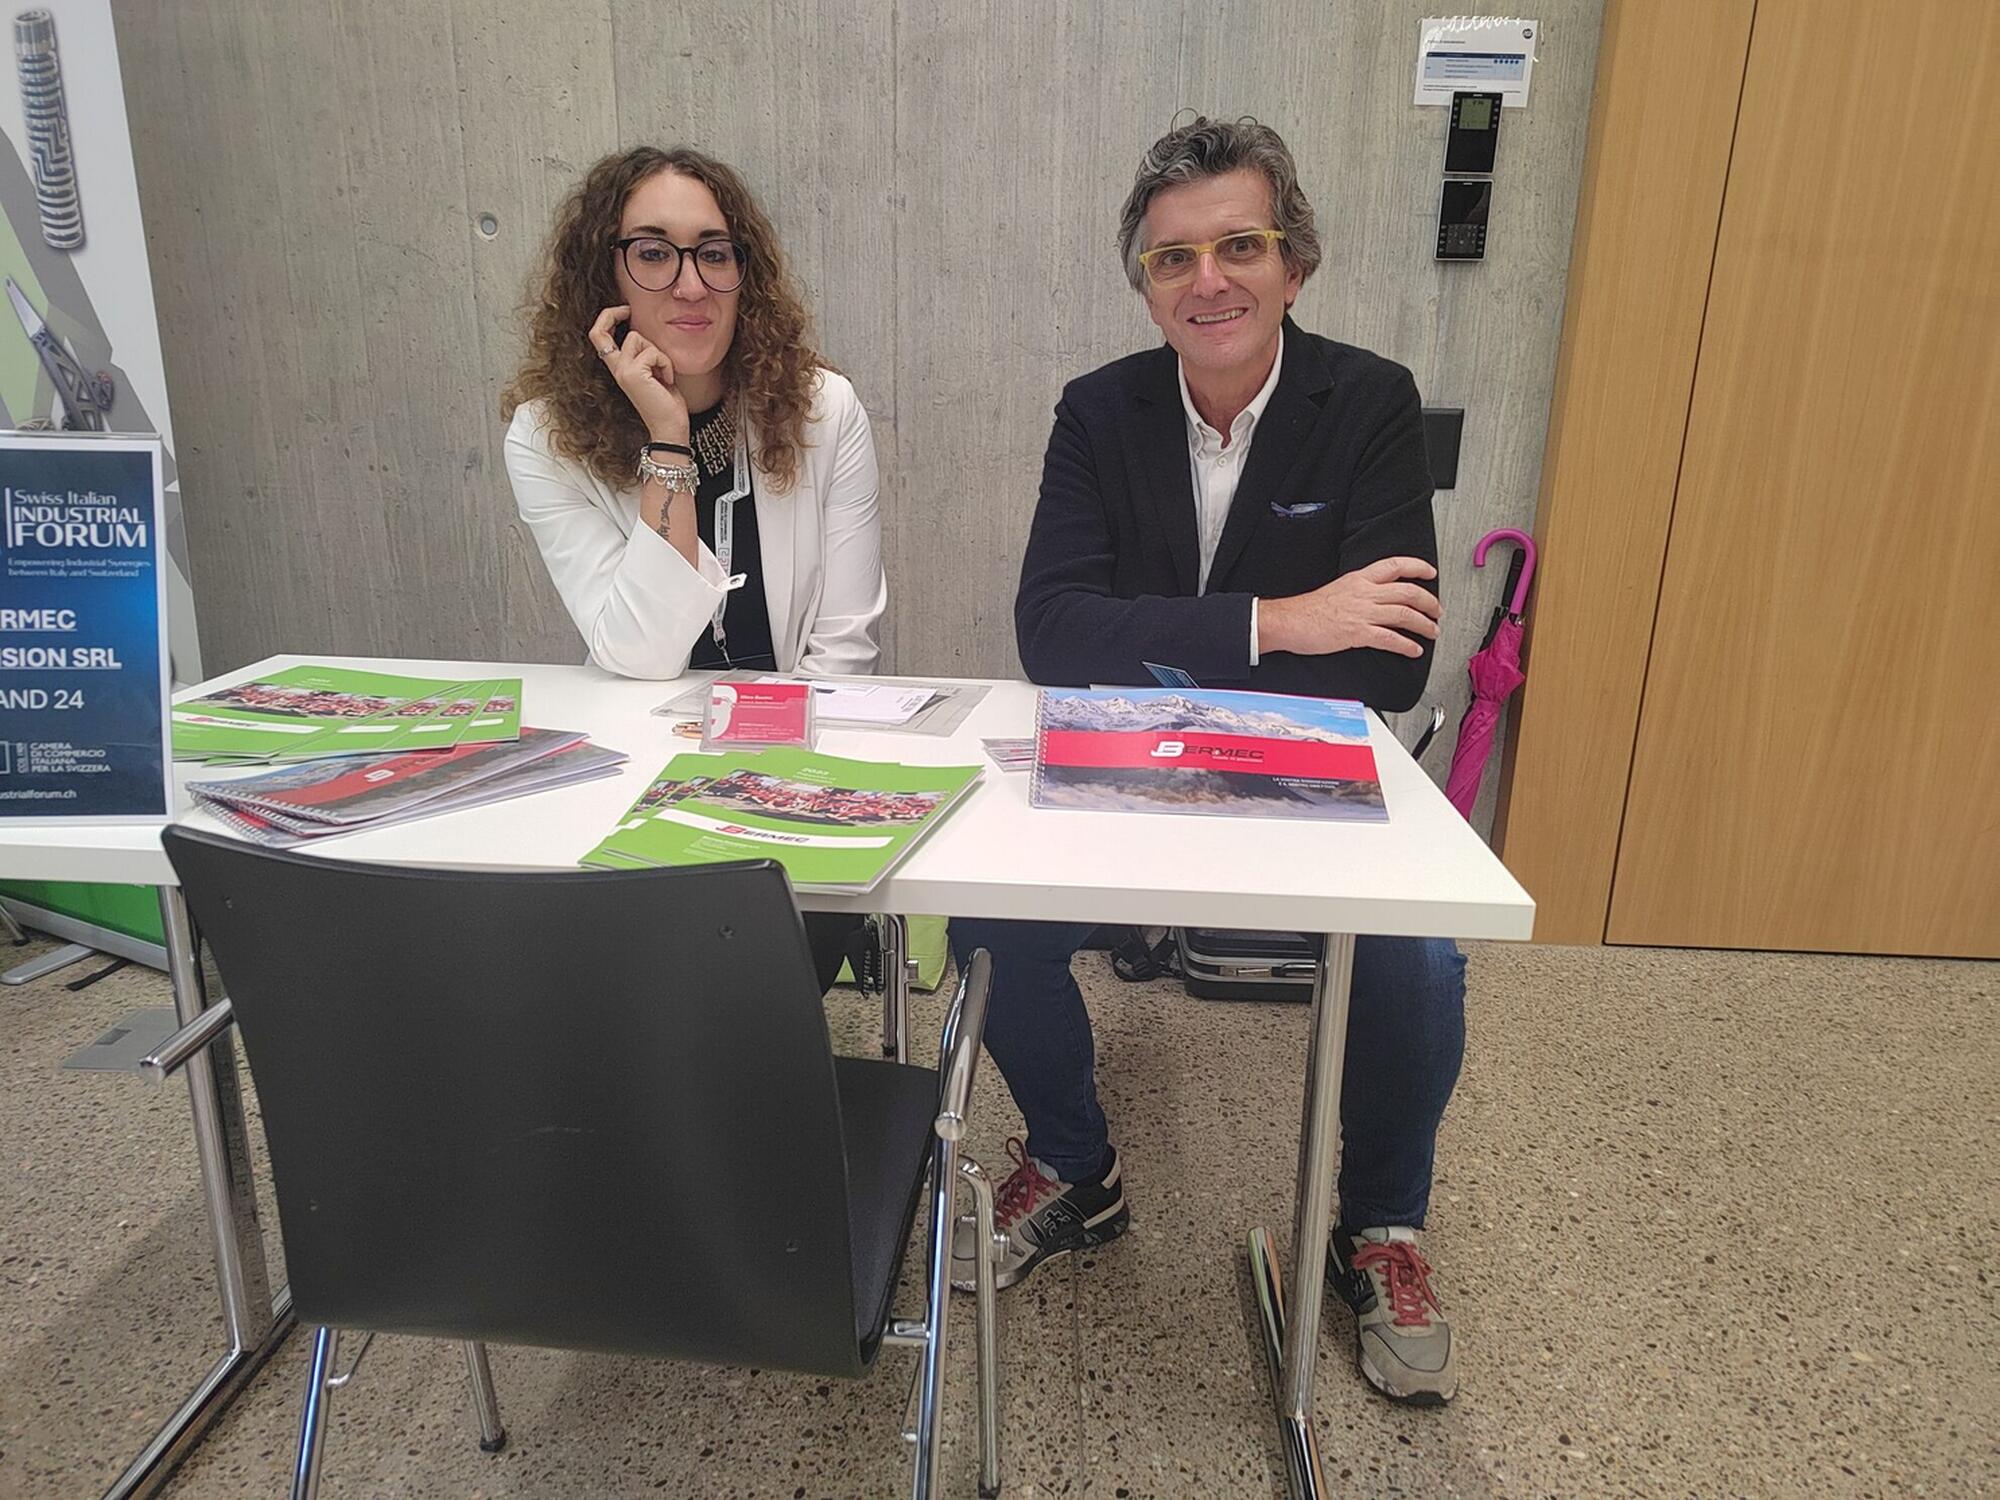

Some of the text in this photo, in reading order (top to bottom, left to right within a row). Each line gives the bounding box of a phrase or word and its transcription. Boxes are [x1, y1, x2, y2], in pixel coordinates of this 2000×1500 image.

[14, 489, 117, 505] Swiss Italian
[14, 506, 146, 524] INDUSTRIAL
[15, 522, 147, 548] FORUM
[66, 558, 106, 567] Industrial
[72, 647, 122, 668] SRL
[53, 689, 85, 709] 24
[30, 742, 73, 750] CAMERA
[43, 749, 106, 758] COMMERCIO
[1150, 740, 1265, 760] BERMEC
[31, 764, 112, 773] PER LA SVIZZERA
[715, 825, 810, 843] BERMEC
